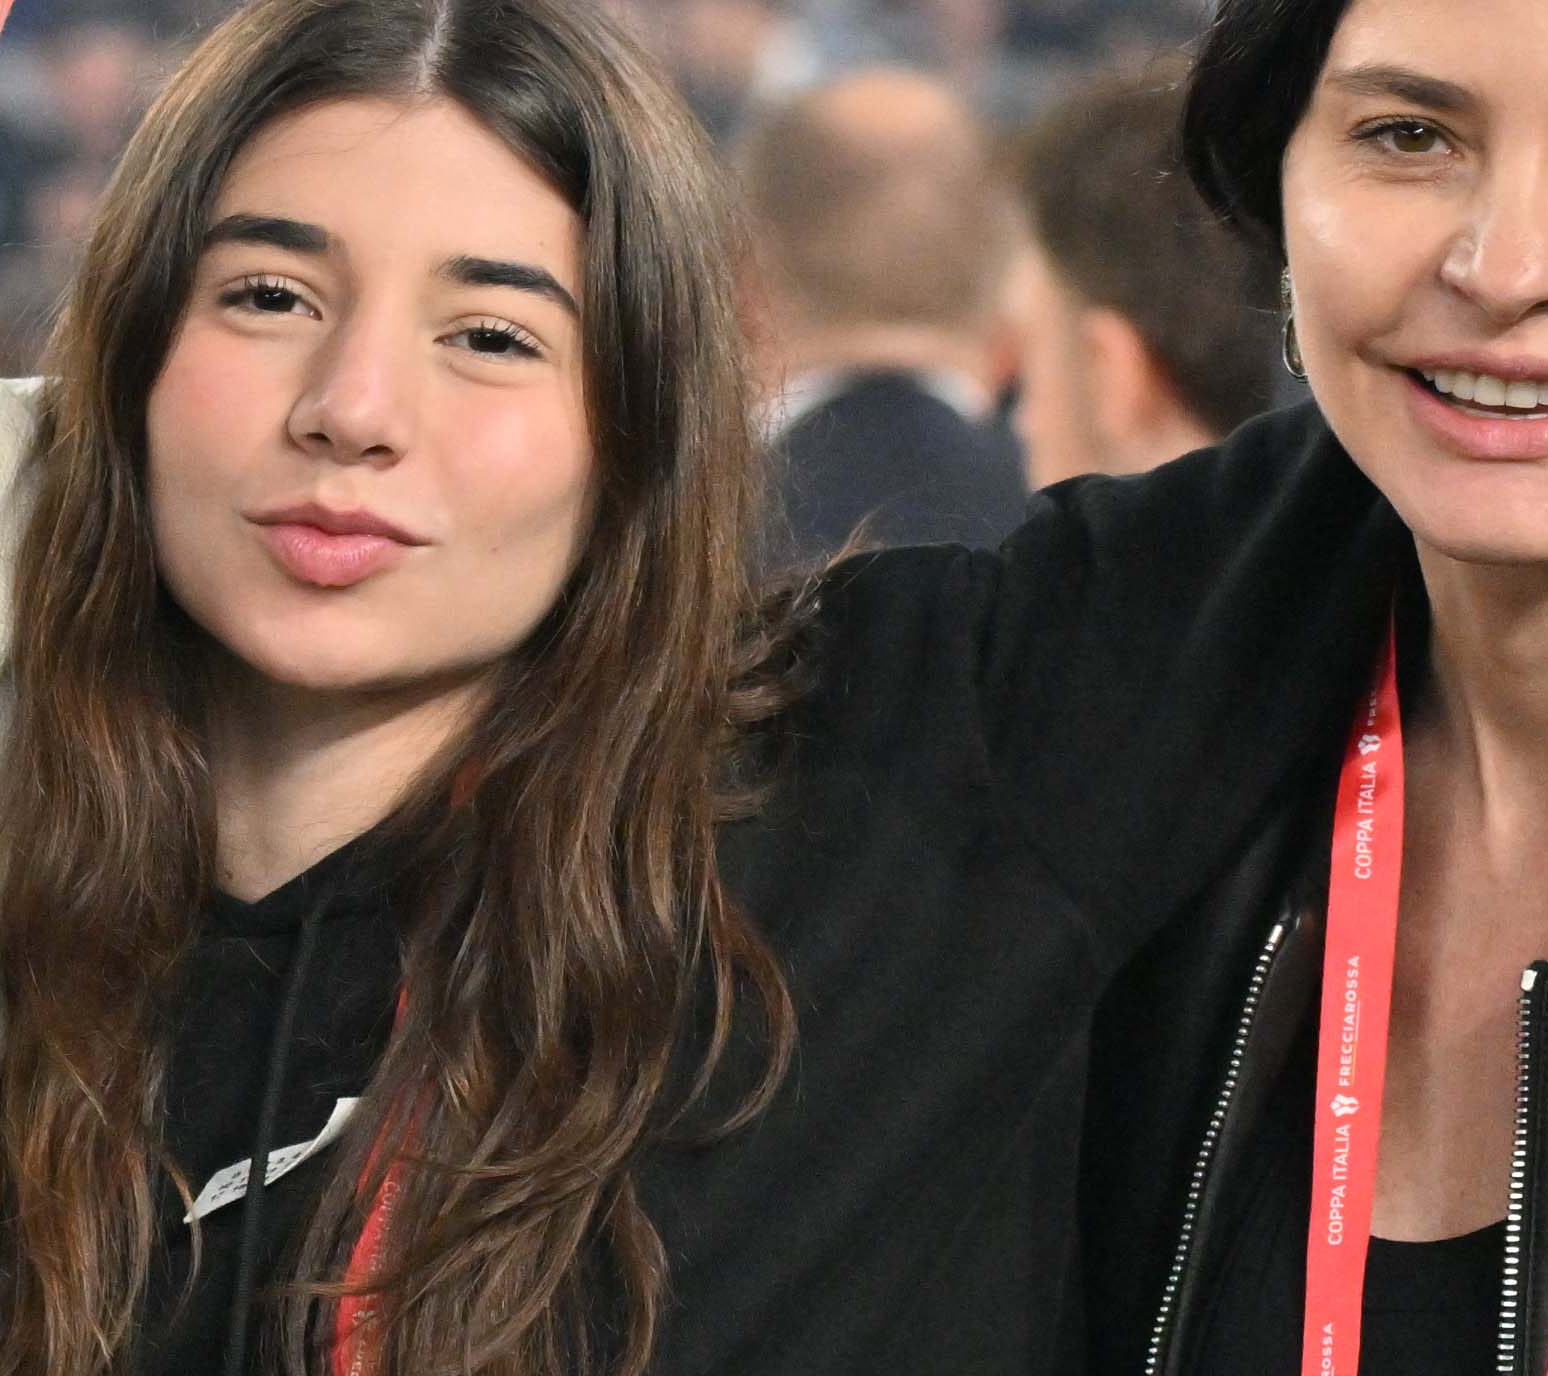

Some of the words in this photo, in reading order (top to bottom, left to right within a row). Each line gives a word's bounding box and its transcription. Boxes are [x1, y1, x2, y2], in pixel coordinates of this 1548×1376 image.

[1359, 762, 1377, 813] ITALIA
[1354, 819, 1373, 879] COPPA
[1339, 956, 1360, 1086] FRECCIAROSSA
[1333, 1124, 1351, 1179] ITALIA
[1327, 1184, 1346, 1245] COPPA
